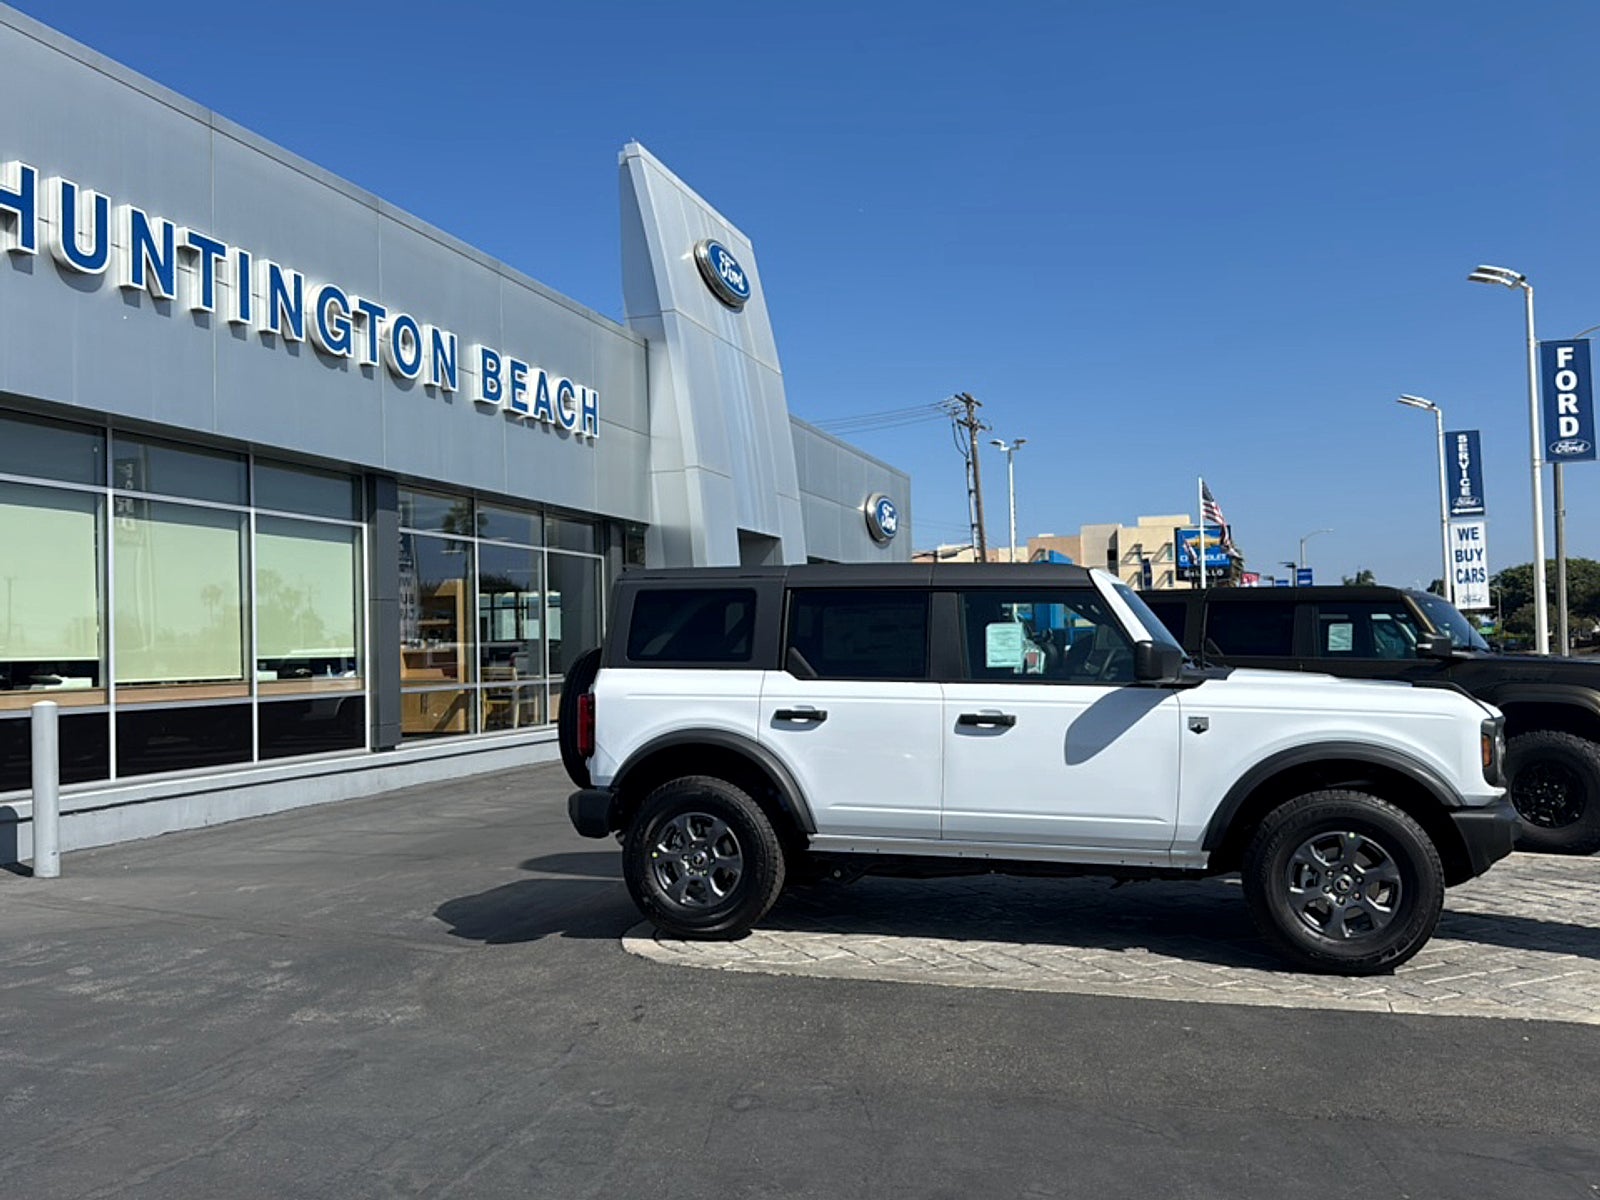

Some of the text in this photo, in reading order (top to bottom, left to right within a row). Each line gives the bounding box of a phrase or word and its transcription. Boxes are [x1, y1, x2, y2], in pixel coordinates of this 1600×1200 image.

[718, 250, 745, 291] Ford
[0, 161, 599, 438] HUNTINGTON BEACH
[1554, 347, 1580, 438] FORD
[1554, 440, 1585, 454] Ford
[1457, 434, 1471, 496] SERVICE
[881, 503, 898, 532] Ford
[1457, 527, 1479, 541] WE
[1455, 548, 1483, 562] BUY
[1456, 568, 1486, 584] CARS
